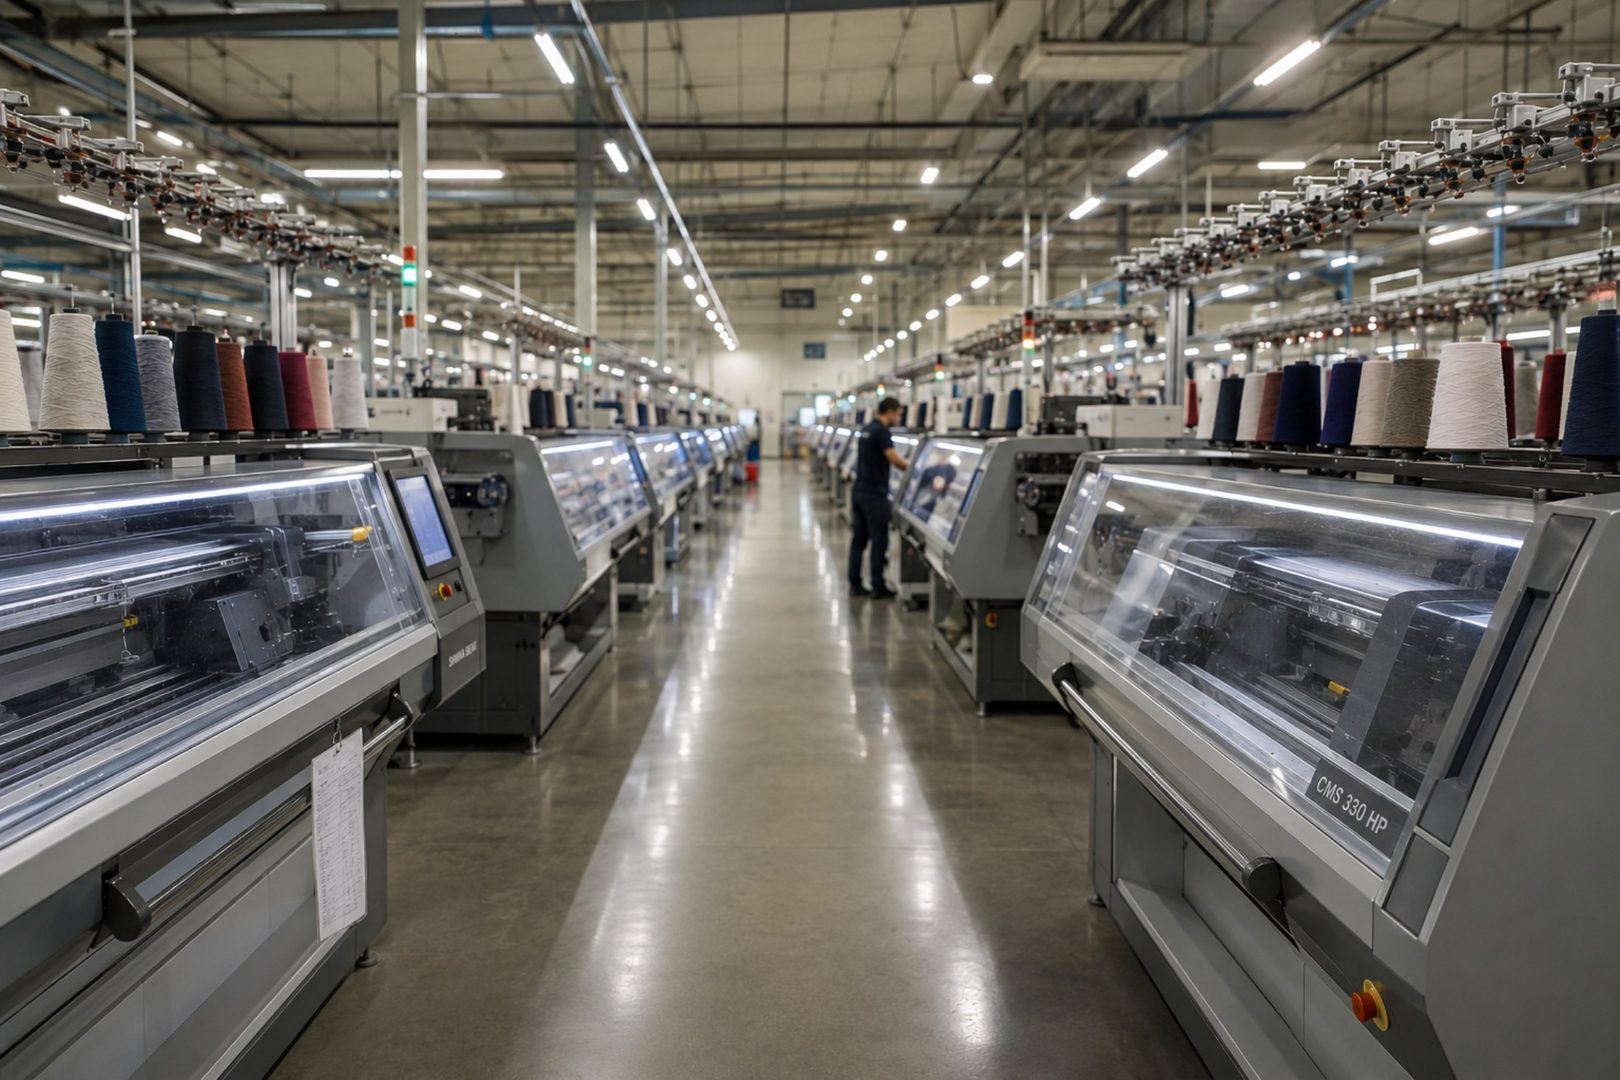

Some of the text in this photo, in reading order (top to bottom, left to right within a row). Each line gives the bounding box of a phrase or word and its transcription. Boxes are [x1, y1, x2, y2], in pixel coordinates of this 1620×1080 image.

[1317, 776, 1388, 834] CMS 330 HP
